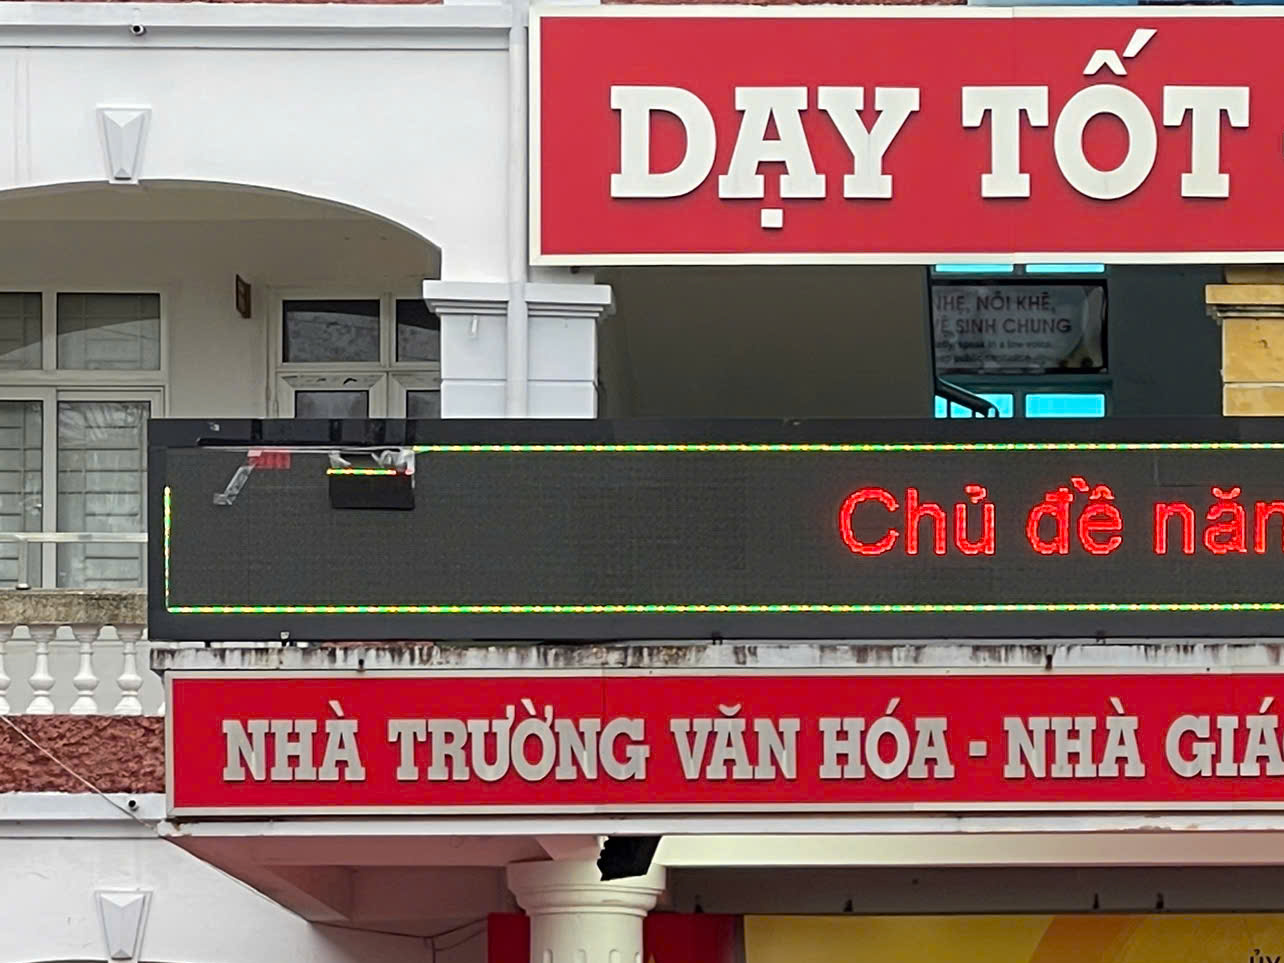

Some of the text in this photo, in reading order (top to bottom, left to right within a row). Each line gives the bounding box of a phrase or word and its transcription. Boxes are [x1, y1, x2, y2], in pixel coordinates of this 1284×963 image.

[611, 86, 920, 228] DẠY
[962, 28, 1250, 200] TỐT
[955, 318, 996, 334] SINH
[1002, 318, 1073, 334] CHUNG
[839, 485, 995, 555] Chủ
[1025, 477, 1123, 555] đề
[223, 700, 366, 781] NHÀ
[388, 698, 650, 782] TRƯỜNG
[670, 703, 801, 780] VĂN
[819, 697, 955, 780] HÓA
[968, 740, 987, 757] -
[1003, 696, 1146, 778] NHÀ
